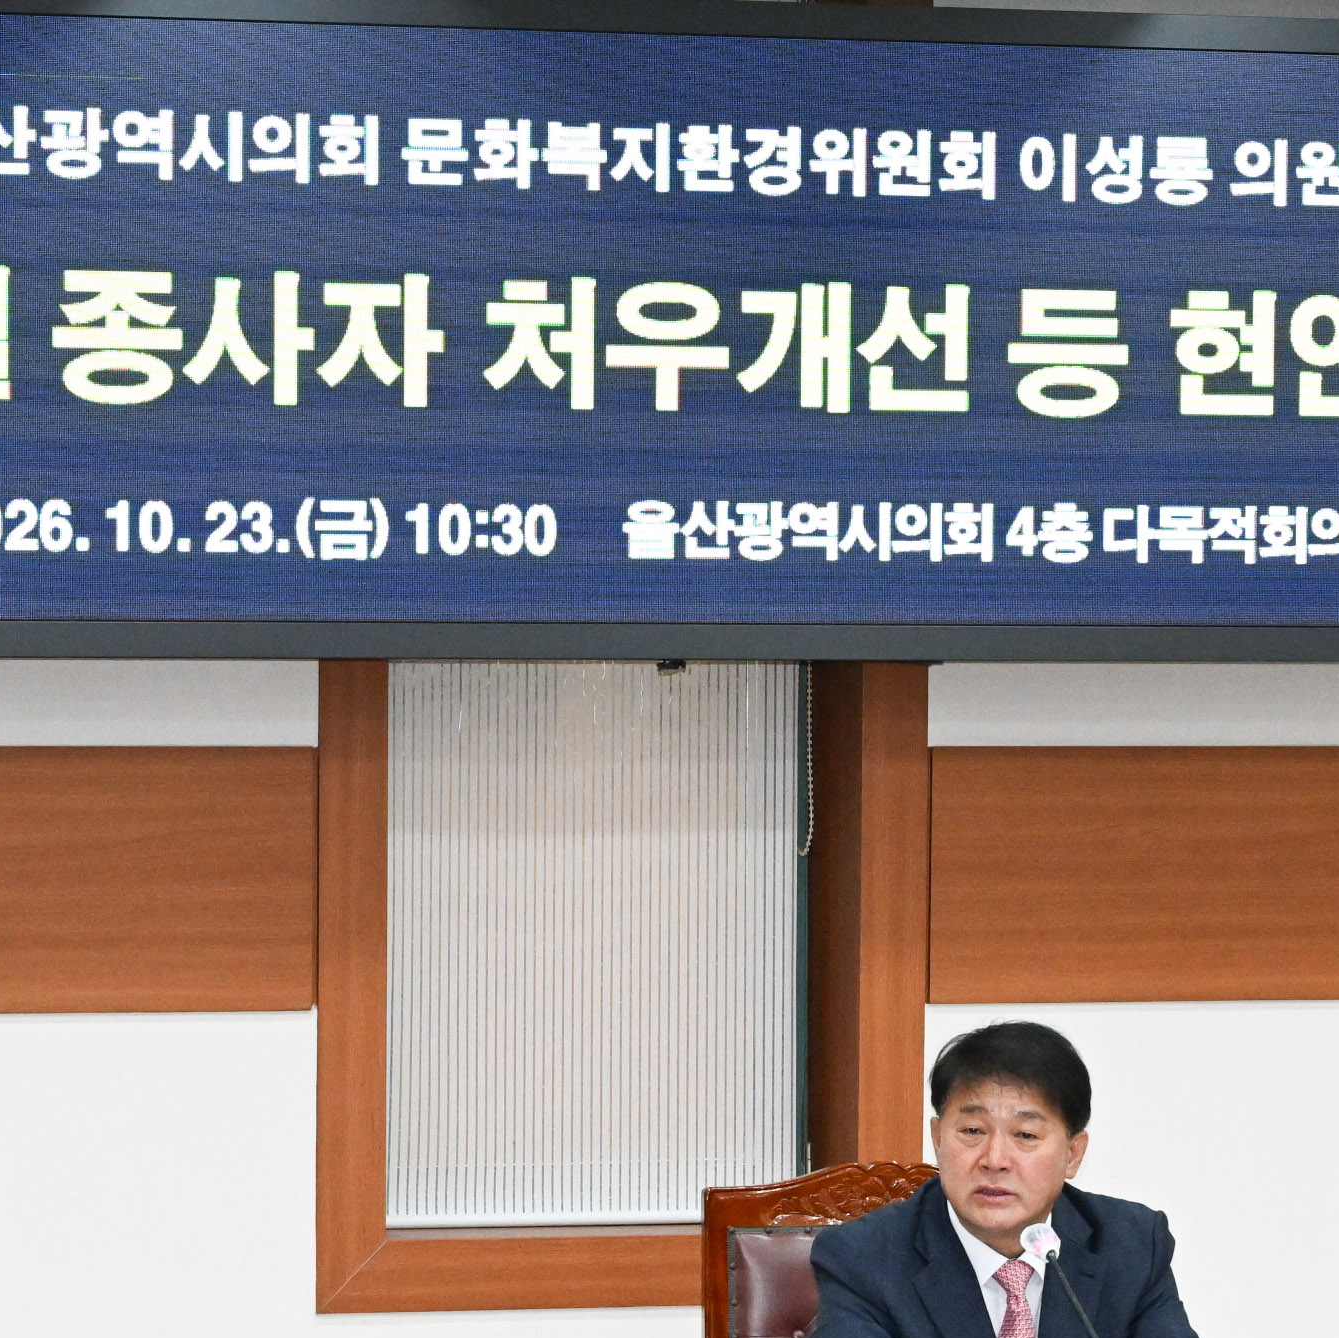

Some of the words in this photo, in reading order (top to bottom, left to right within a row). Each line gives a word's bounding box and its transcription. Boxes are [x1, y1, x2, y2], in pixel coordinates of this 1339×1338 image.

[400, 117, 997, 201] 문화복지환경위원회
[1018, 132, 1214, 206] 이성룡
[51, 268, 445, 409] 종사자
[482, 276, 971, 414] 처우개선
[1006, 288, 1130, 418] 등
[106, 499, 191, 553] 10.
[204, 497, 389, 561] 23.(금)
[405, 502, 558, 557] 10:30
[621, 498, 995, 563] 울산광역시의회
[1004, 502, 1095, 564] 4층
